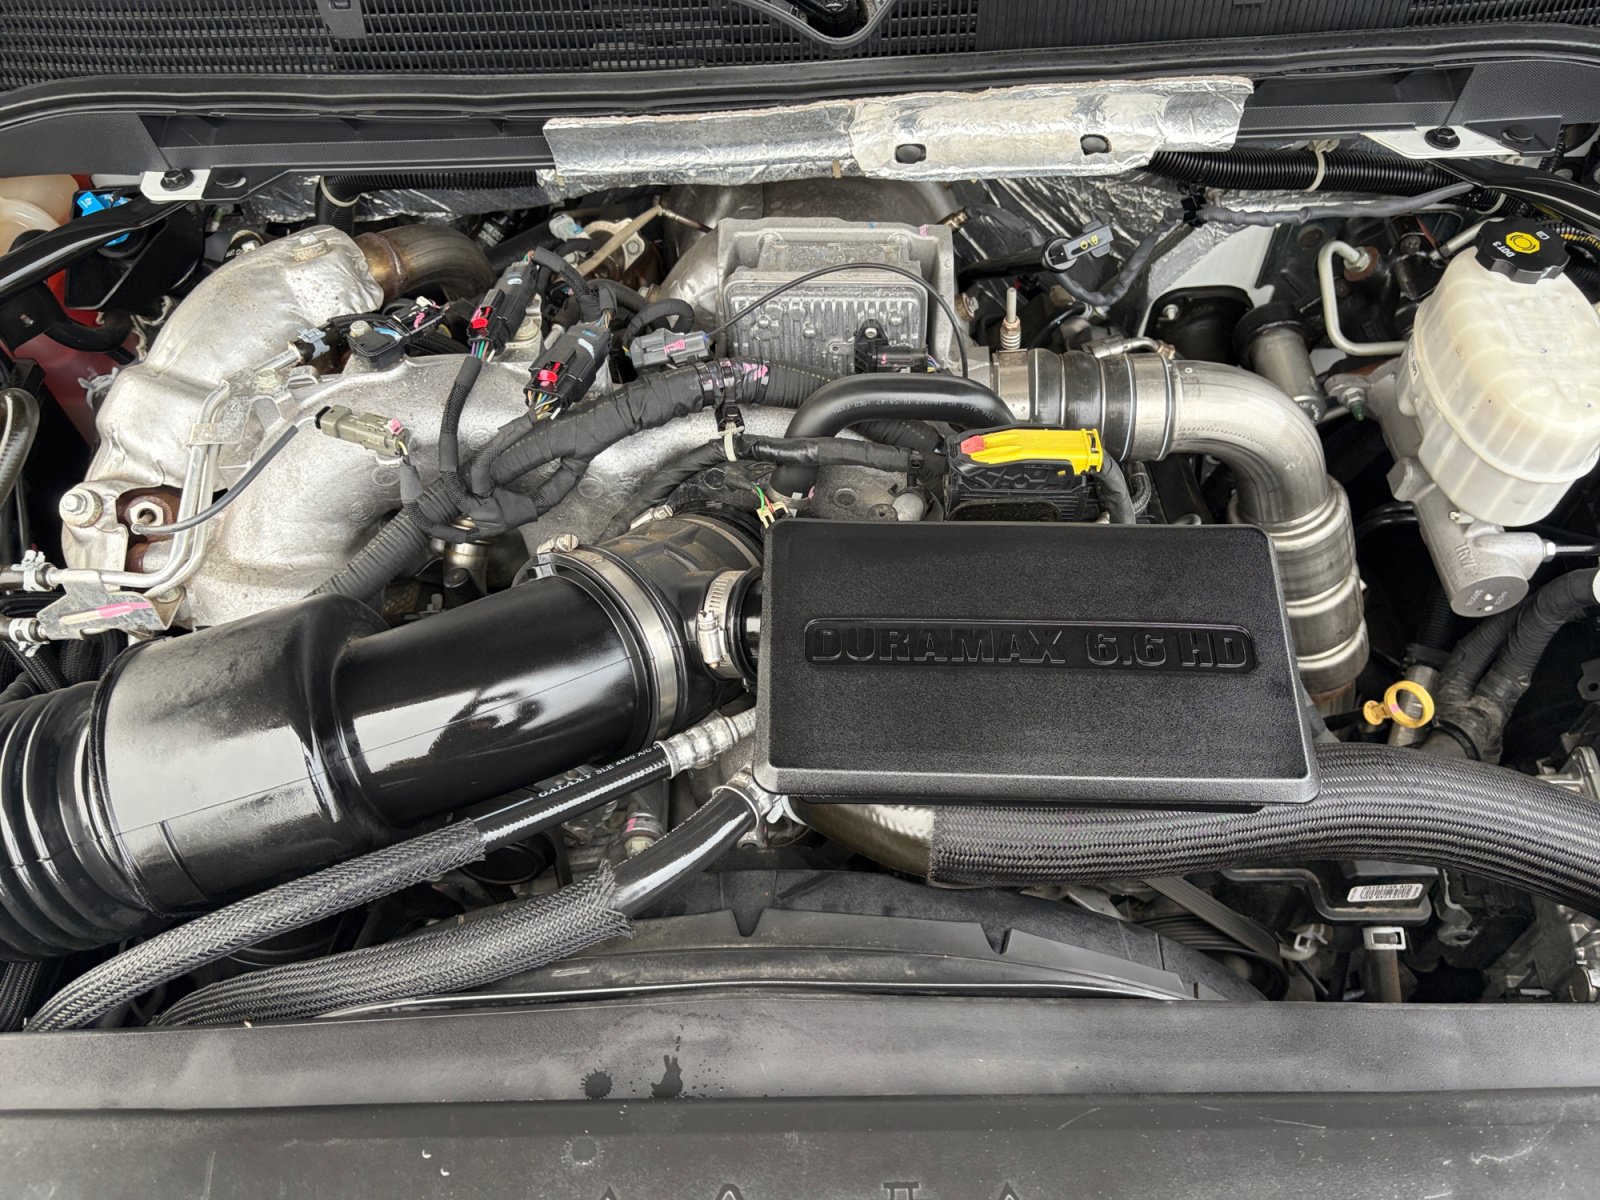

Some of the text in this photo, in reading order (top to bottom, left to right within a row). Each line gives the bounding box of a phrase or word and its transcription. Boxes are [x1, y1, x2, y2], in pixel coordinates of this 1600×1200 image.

[812, 627, 1248, 668] DURAMAX 6.6 HD
[538, 773, 592, 798] GALAXY
[595, 764, 615, 775] SLE
